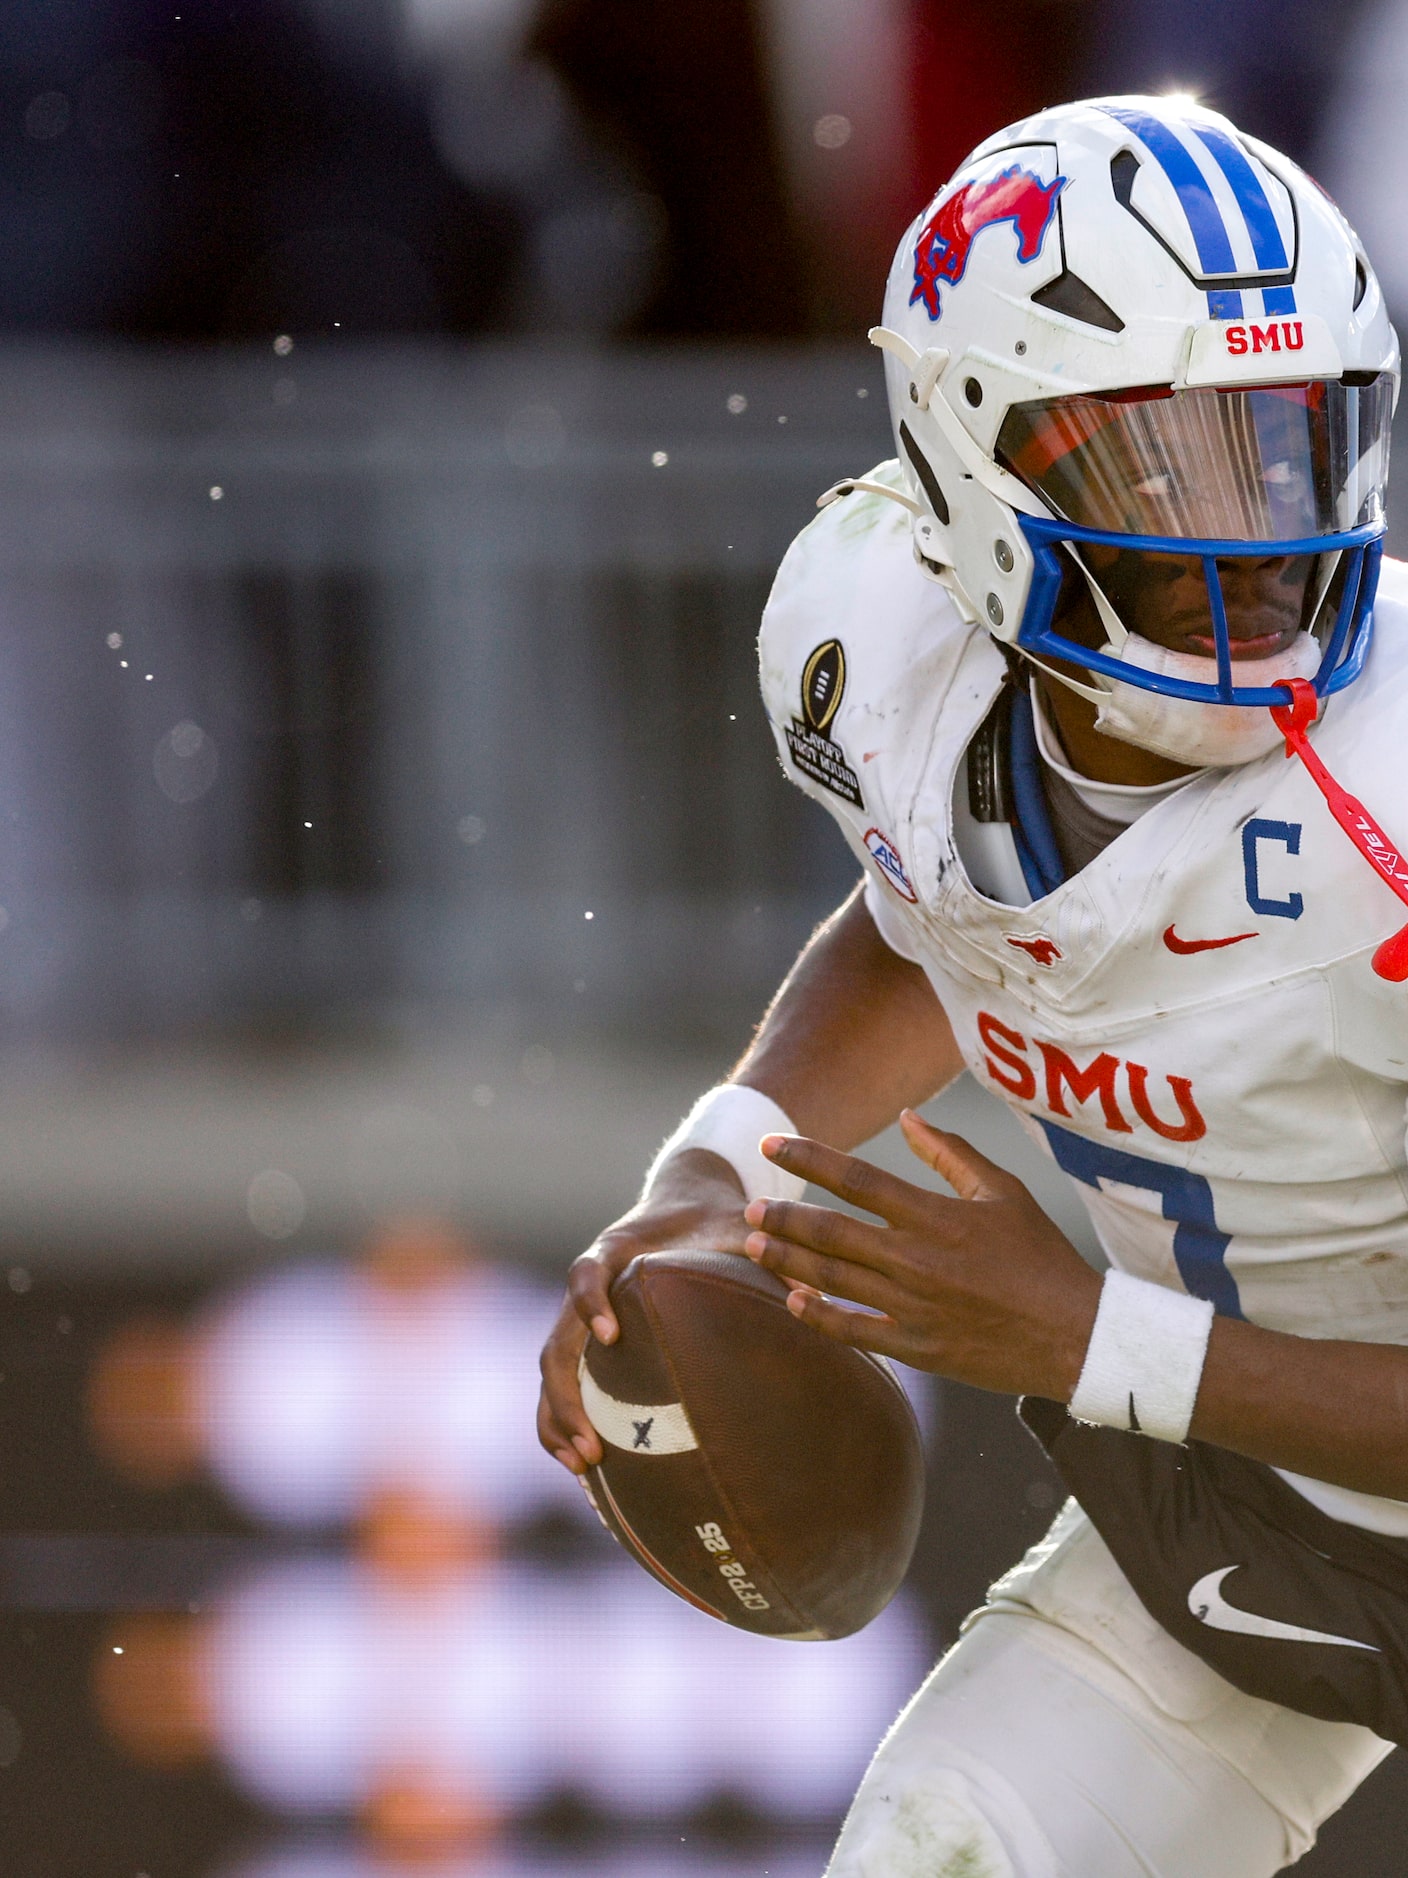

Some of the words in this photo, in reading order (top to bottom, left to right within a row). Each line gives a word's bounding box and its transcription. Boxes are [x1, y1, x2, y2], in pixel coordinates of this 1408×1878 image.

[1225, 321, 1304, 355] SMU
[795, 722, 844, 761] PLAYOFF
[818, 753, 859, 789] ROUND
[1242, 818, 1304, 921] C
[978, 1011, 1207, 1142] SMU
[1030, 1114, 1249, 1321] 7
